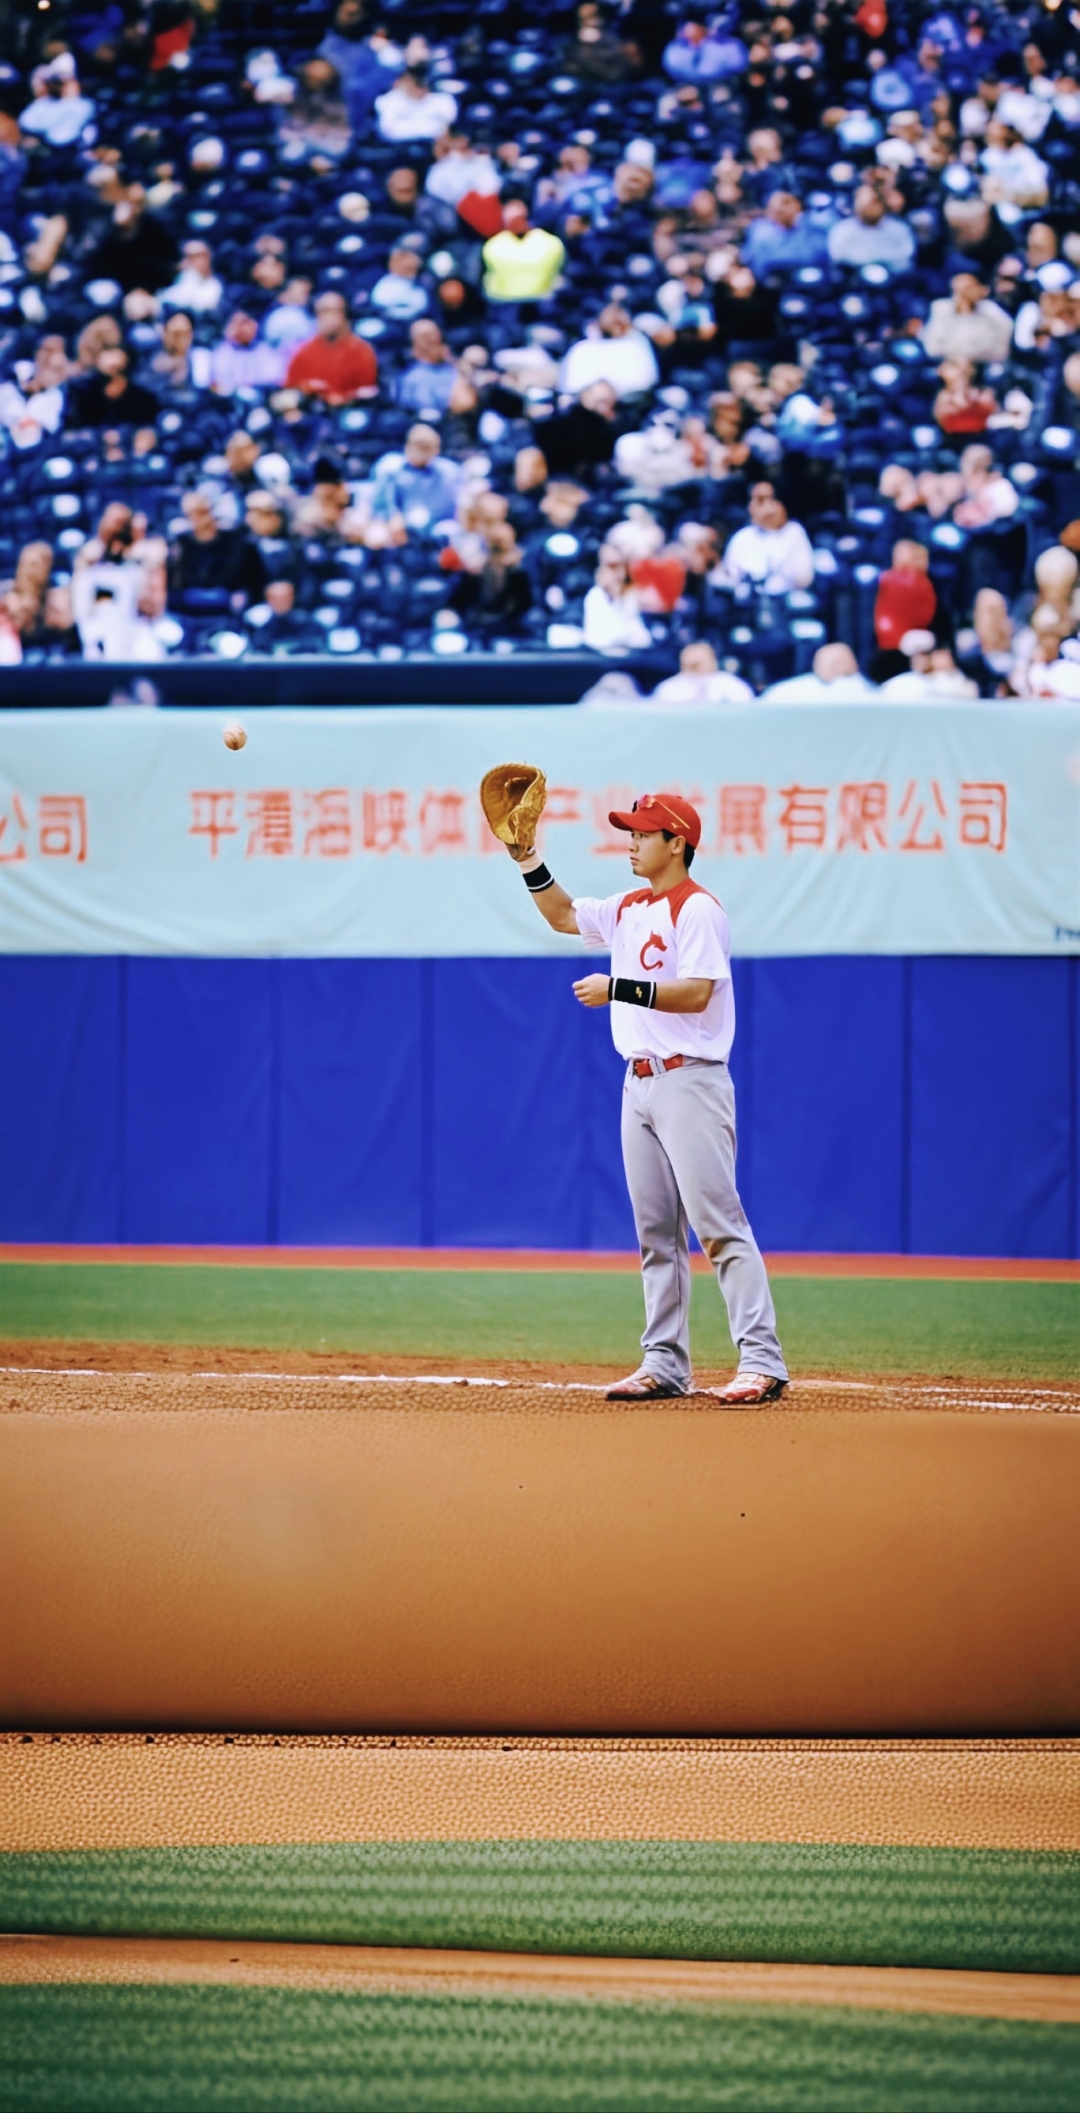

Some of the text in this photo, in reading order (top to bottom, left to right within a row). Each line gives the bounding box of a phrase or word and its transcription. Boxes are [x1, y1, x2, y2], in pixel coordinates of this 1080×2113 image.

[188, 780, 1008, 859] 平潭海峡体产业展有限公司
